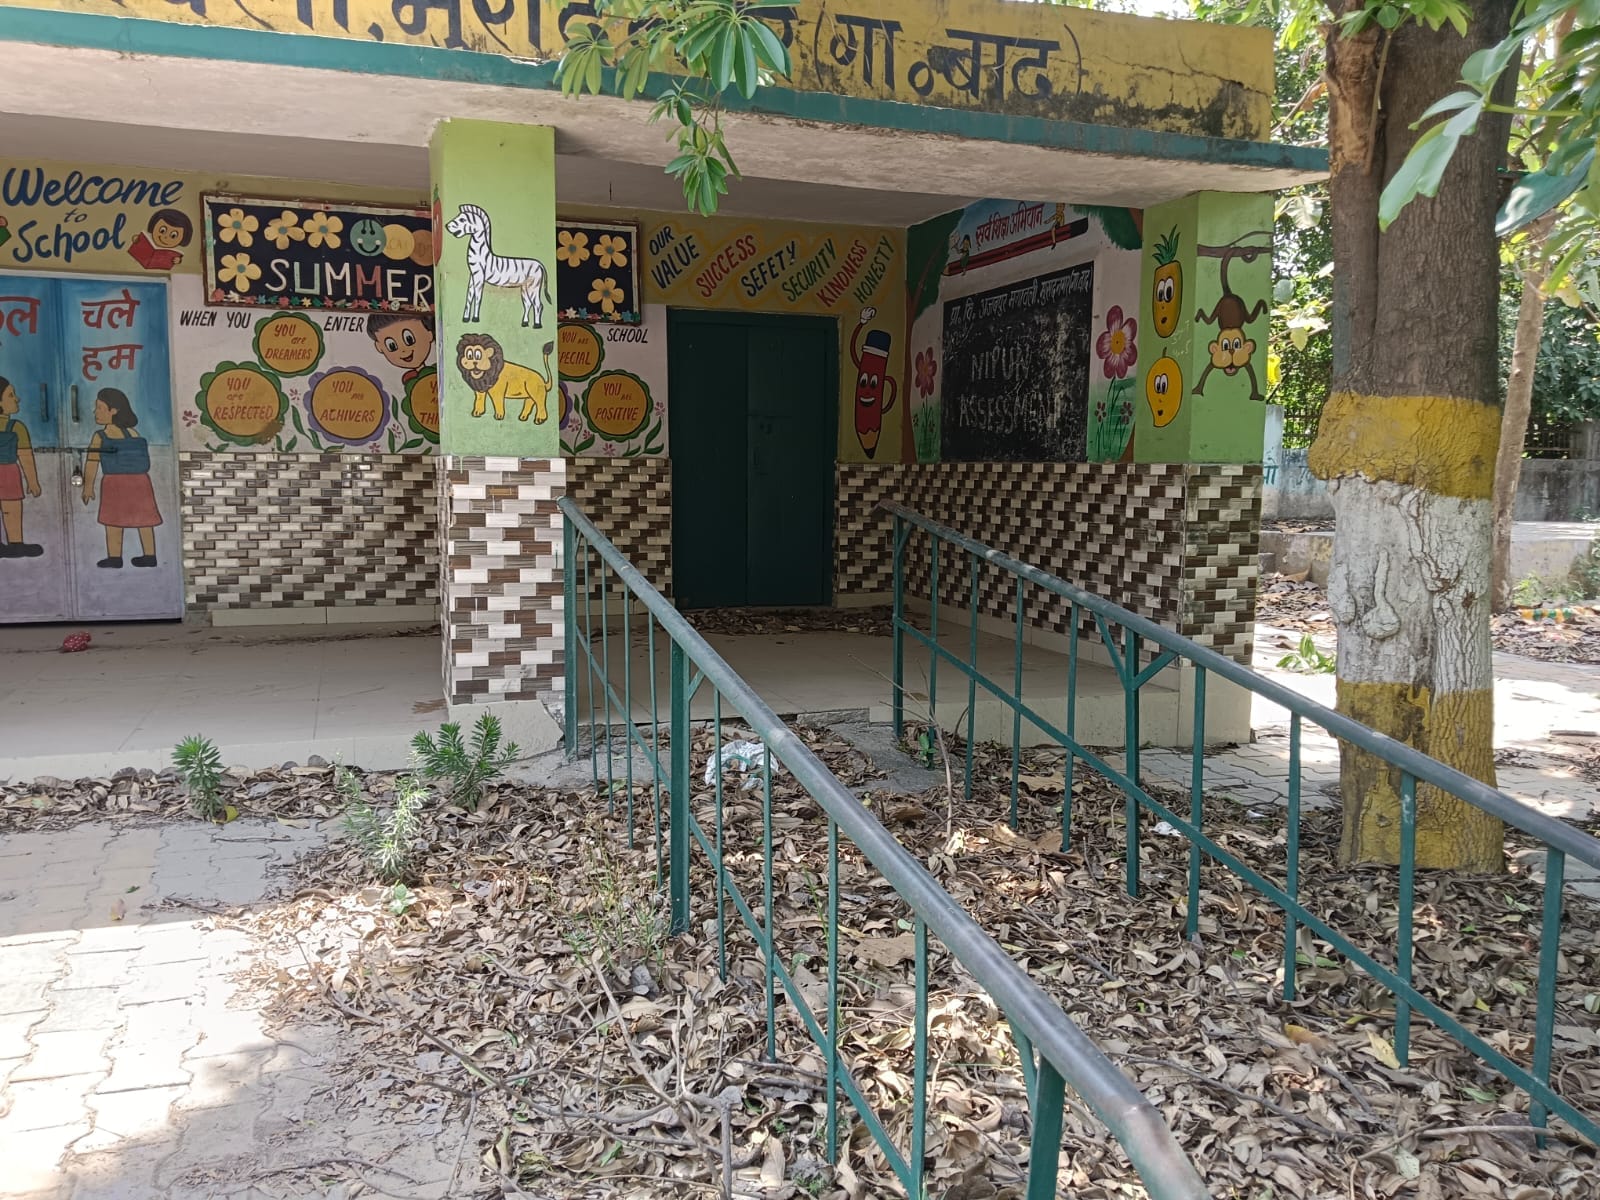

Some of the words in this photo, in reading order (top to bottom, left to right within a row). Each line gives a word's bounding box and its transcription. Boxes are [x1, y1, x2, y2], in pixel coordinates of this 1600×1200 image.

[2, 167, 184, 208] Welcome
[64, 207, 88, 223] to
[13, 212, 127, 263] School
[649, 225, 674, 256] OUR
[651, 235, 700, 289] VALUE
[695, 234, 757, 298] SUCCESS
[740, 240, 796, 298] SEFETY
[781, 237, 837, 303] SECURITY
[852, 235, 895, 304] HONESTY
[265, 258, 433, 313] SUMMER
[81, 288, 140, 329] चले
[179, 310, 216, 327] WHEN
[226, 313, 252, 329] YOU
[323, 316, 366, 333] ENTER
[273, 323, 297, 337] YOU
[562, 331, 577, 344] YOU
[606, 328, 649, 344] SCHOOL
[82, 344, 143, 381] हम
[264, 348, 313, 361] DREAMERS
[558, 351, 592, 366] PECIAL
[226, 377, 252, 391] YOU
[332, 380, 354, 393] YOU
[603, 382, 622, 396] YOU
[213, 405, 274, 421] RESPECTED
[319, 408, 376, 423] ACHIVERS
[594, 407, 639, 421] POSITIVE
